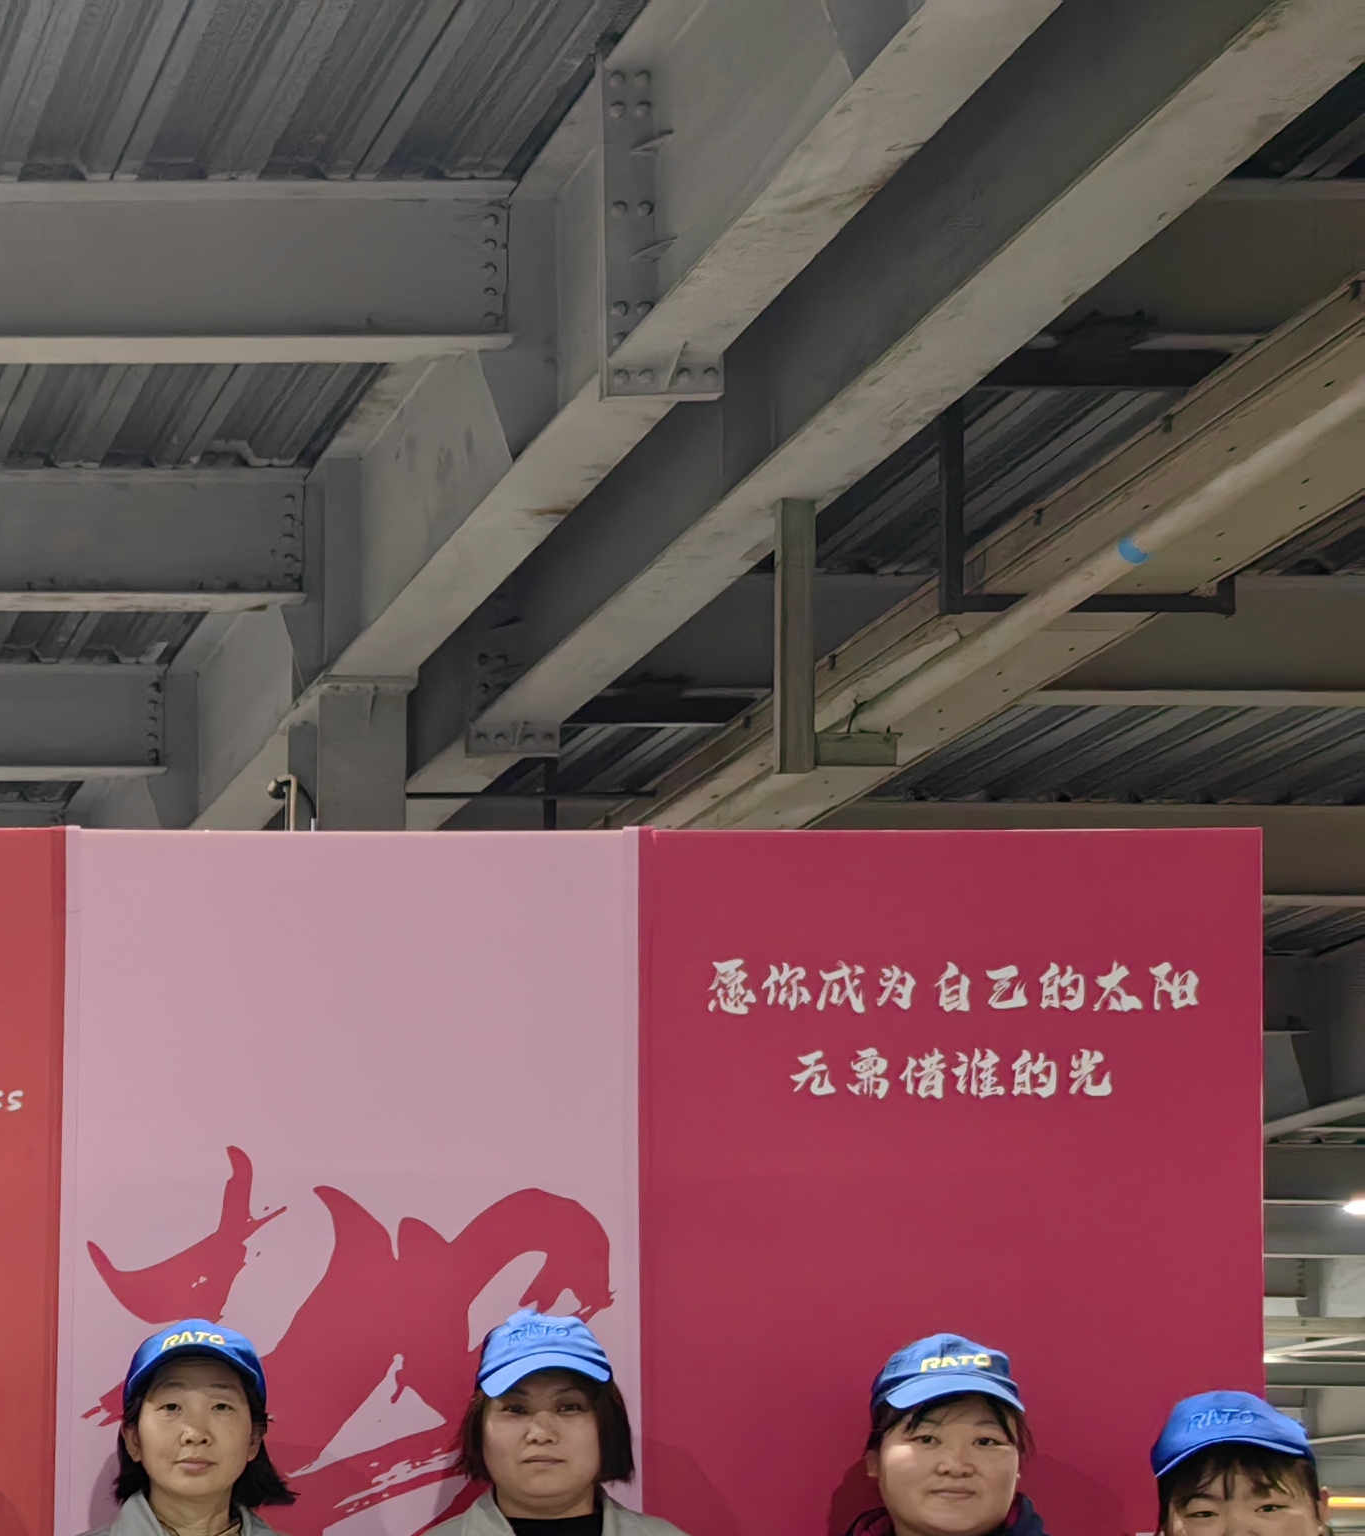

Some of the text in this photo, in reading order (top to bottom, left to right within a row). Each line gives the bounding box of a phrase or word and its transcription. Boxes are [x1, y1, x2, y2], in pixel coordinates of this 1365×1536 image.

[707, 959, 1200, 1015] 愿你成为自己的太阳
[788, 1047, 1113, 1099] 无需借谁的光
[161, 1331, 226, 1351] RATO
[920, 1353, 992, 1373] RATO
